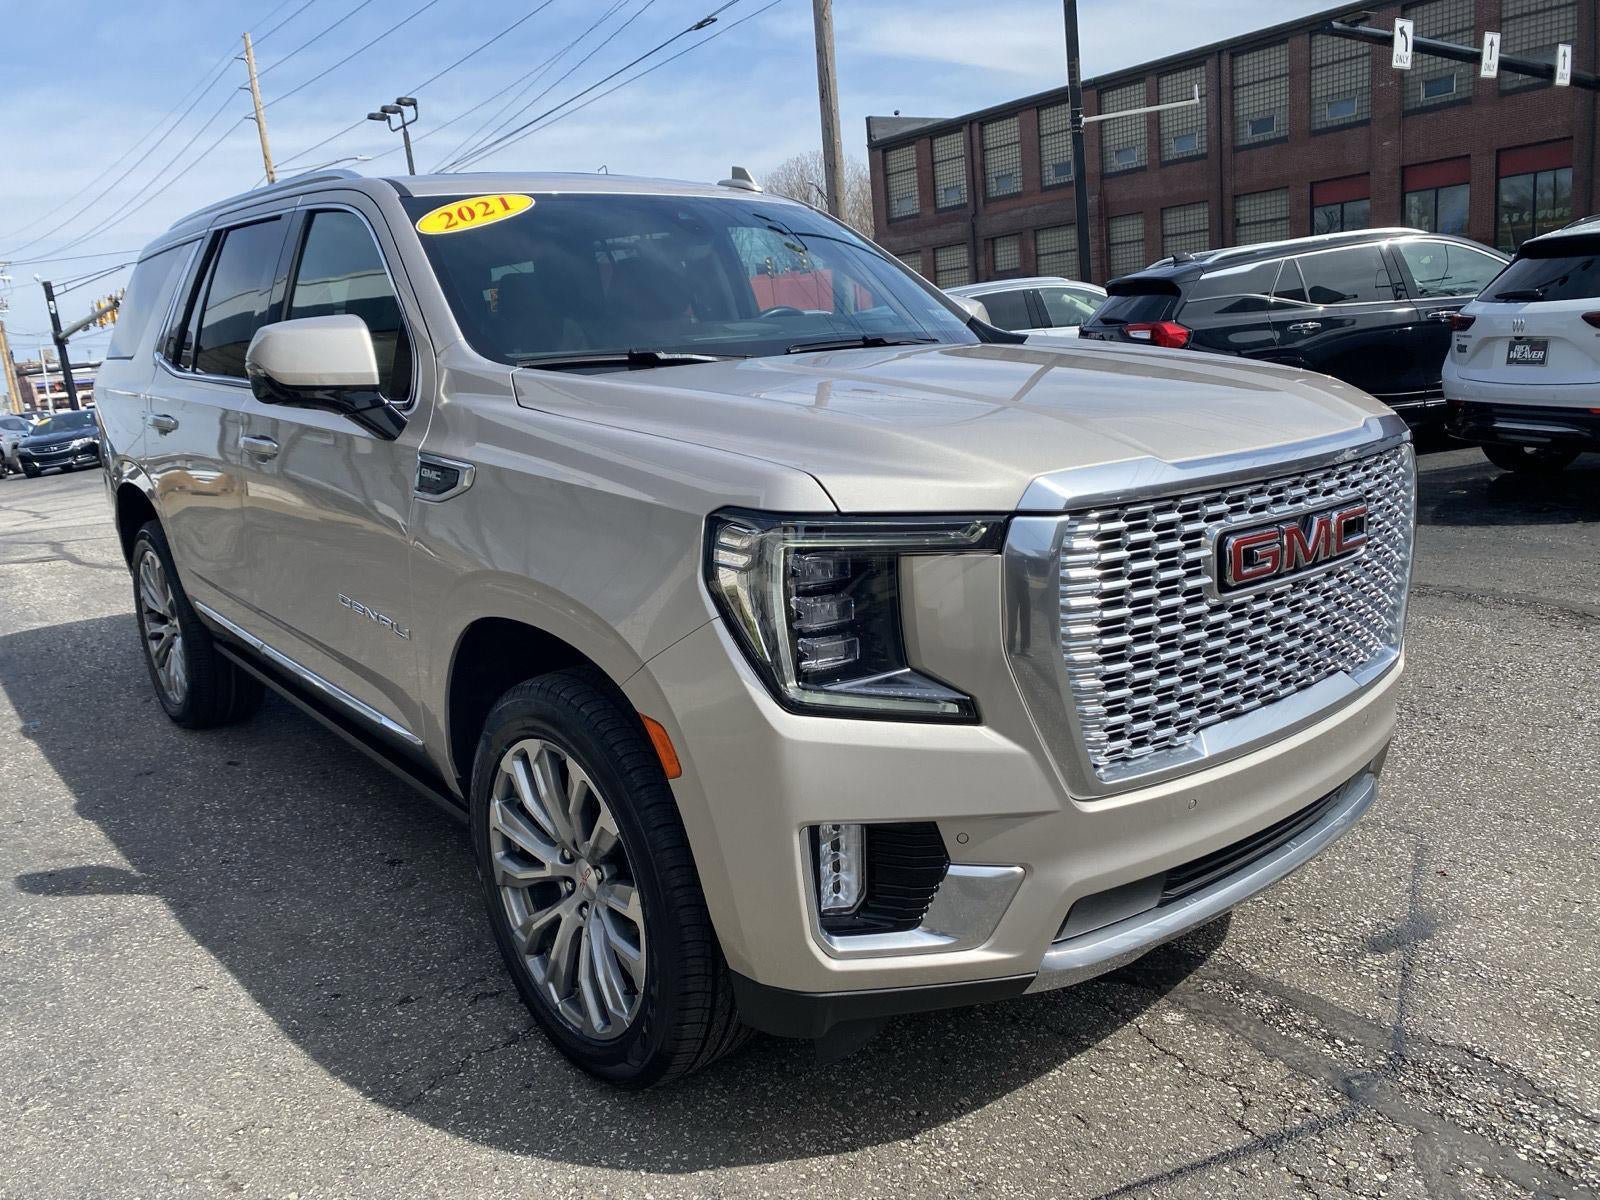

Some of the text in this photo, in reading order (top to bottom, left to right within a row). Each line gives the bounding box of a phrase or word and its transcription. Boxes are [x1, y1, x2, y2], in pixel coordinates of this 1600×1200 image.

[1395, 54, 1410, 65] ONLY
[1484, 62, 1496, 72] ONLY
[439, 196, 511, 229] 2021
[1509, 351, 1545, 359] WEAVER
[420, 468, 441, 480] GMC
[1227, 504, 1368, 585] GMC
[337, 592, 410, 641] DENALI
